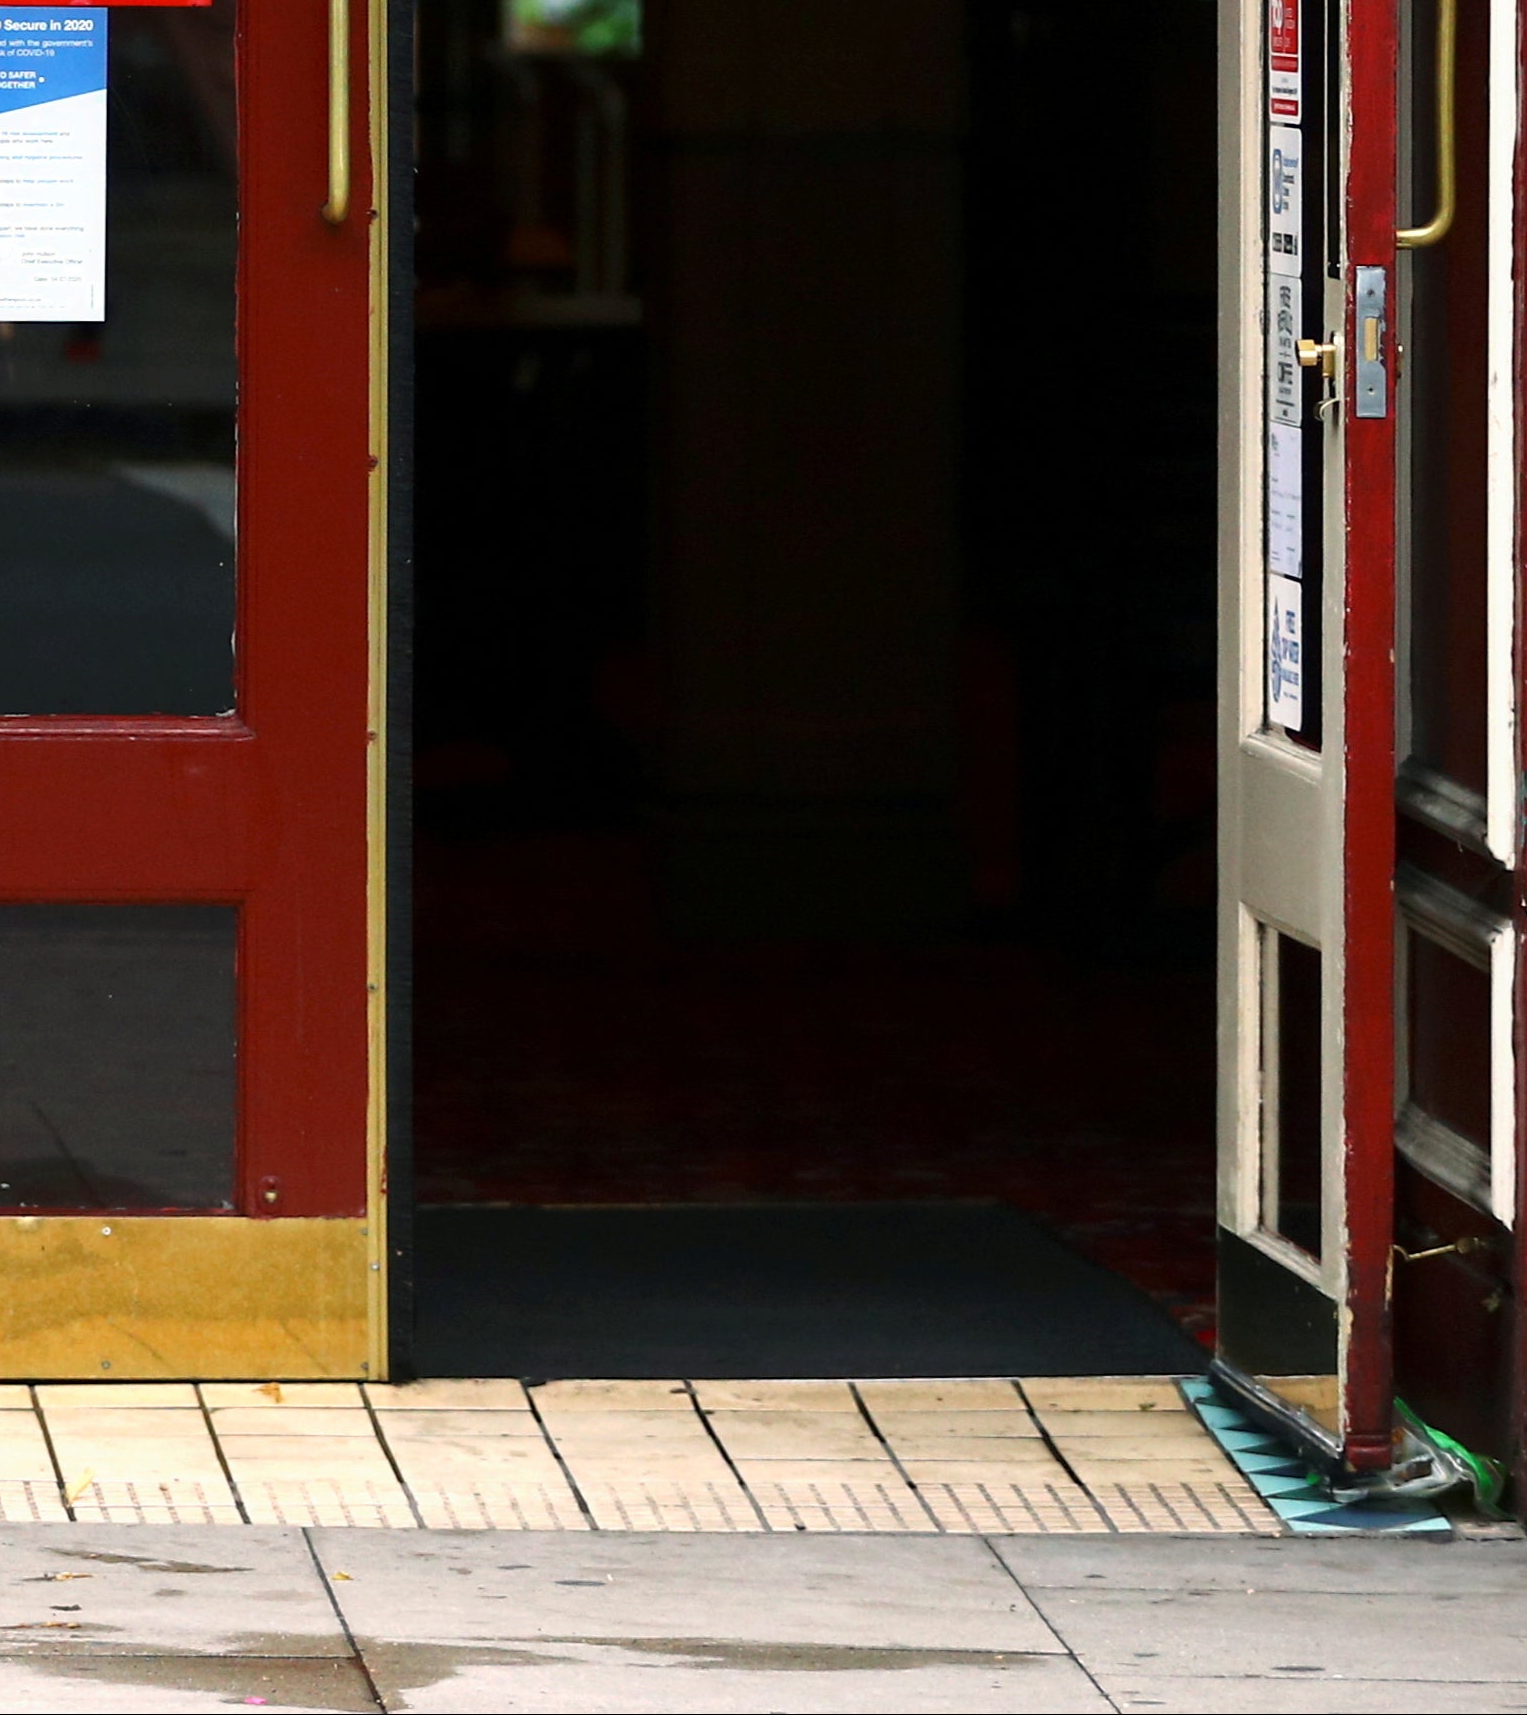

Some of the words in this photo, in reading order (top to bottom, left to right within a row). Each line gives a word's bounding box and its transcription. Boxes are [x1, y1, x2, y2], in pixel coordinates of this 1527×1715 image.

[4, 19, 48, 31] Secure
[50, 19, 61, 31] in
[64, 19, 93, 31] 2020
